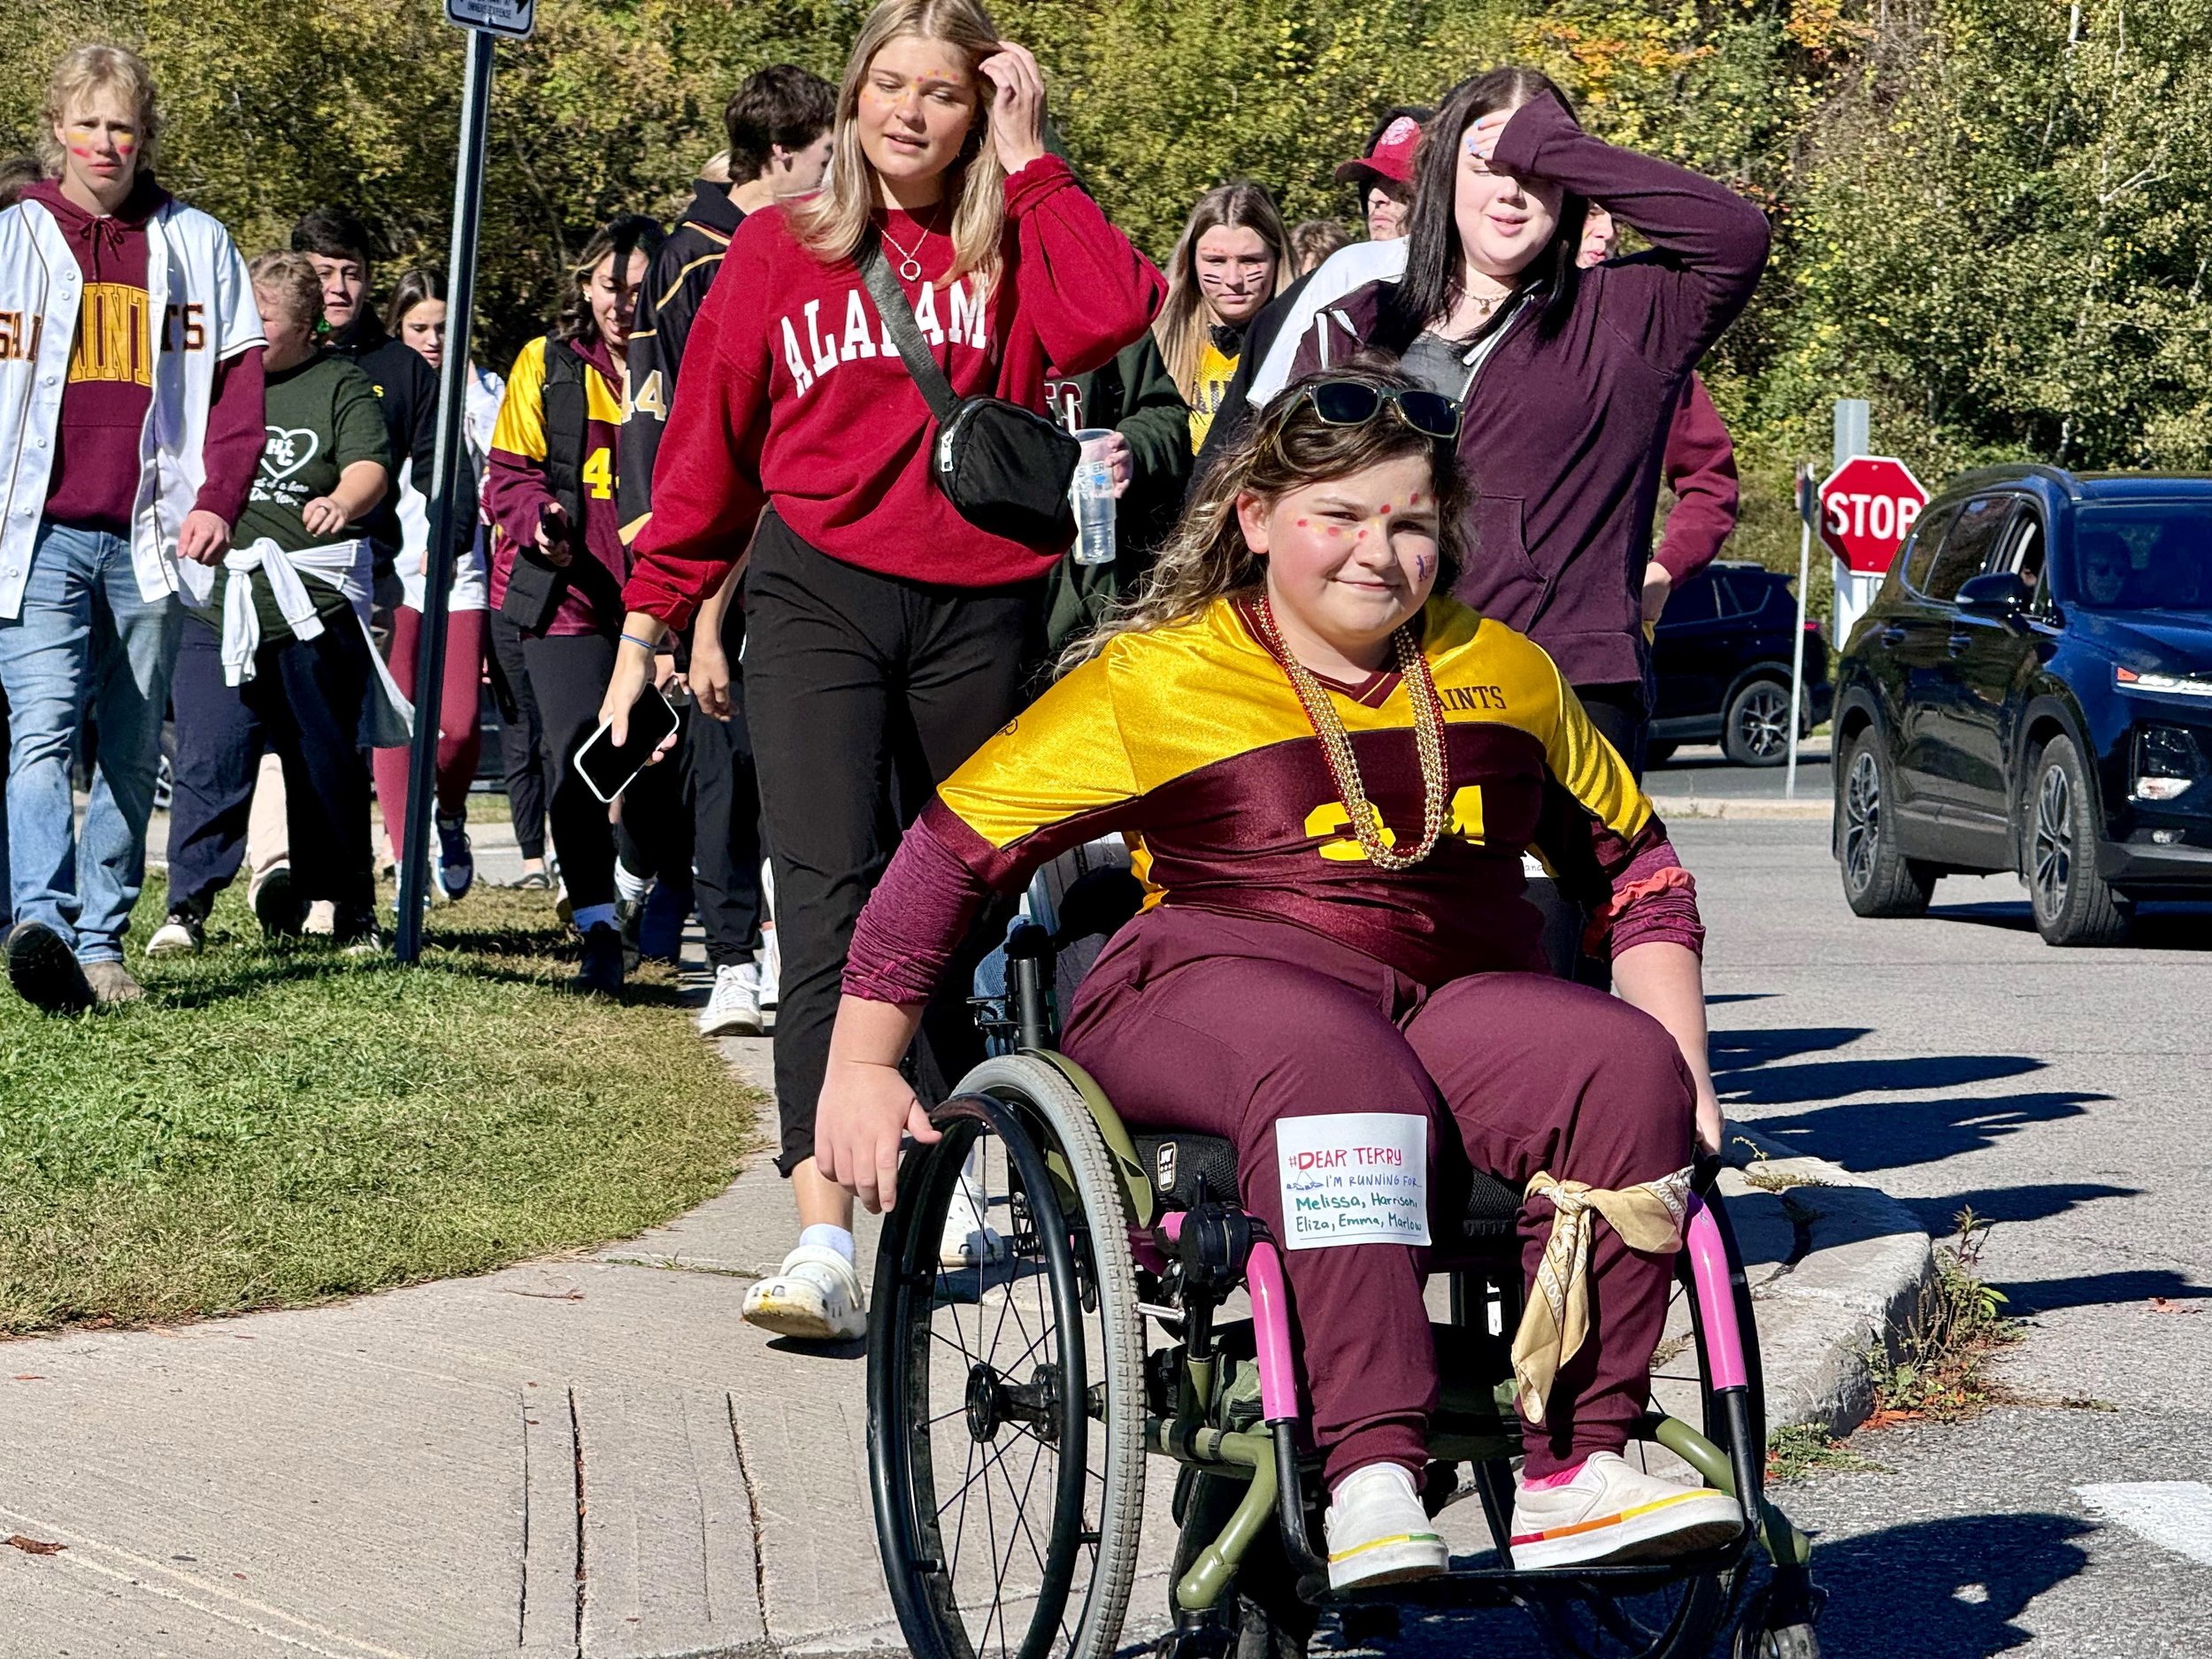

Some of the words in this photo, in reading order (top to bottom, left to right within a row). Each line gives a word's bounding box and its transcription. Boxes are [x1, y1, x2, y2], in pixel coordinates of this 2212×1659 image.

[1826, 491, 1922, 541] STOP
[1288, 1149, 1348, 1171] #DEAR
[1353, 1147, 1402, 1167] TERRY
[1325, 1175, 1342, 1187] I'M
[1349, 1173, 1400, 1187] RUNNING
[1296, 1194, 1366, 1211] Melissa,
[1296, 1216, 1335, 1233] Eliza,
[1339, 1213, 1384, 1228] Emma,
[1388, 1211, 1422, 1232] Marlow
